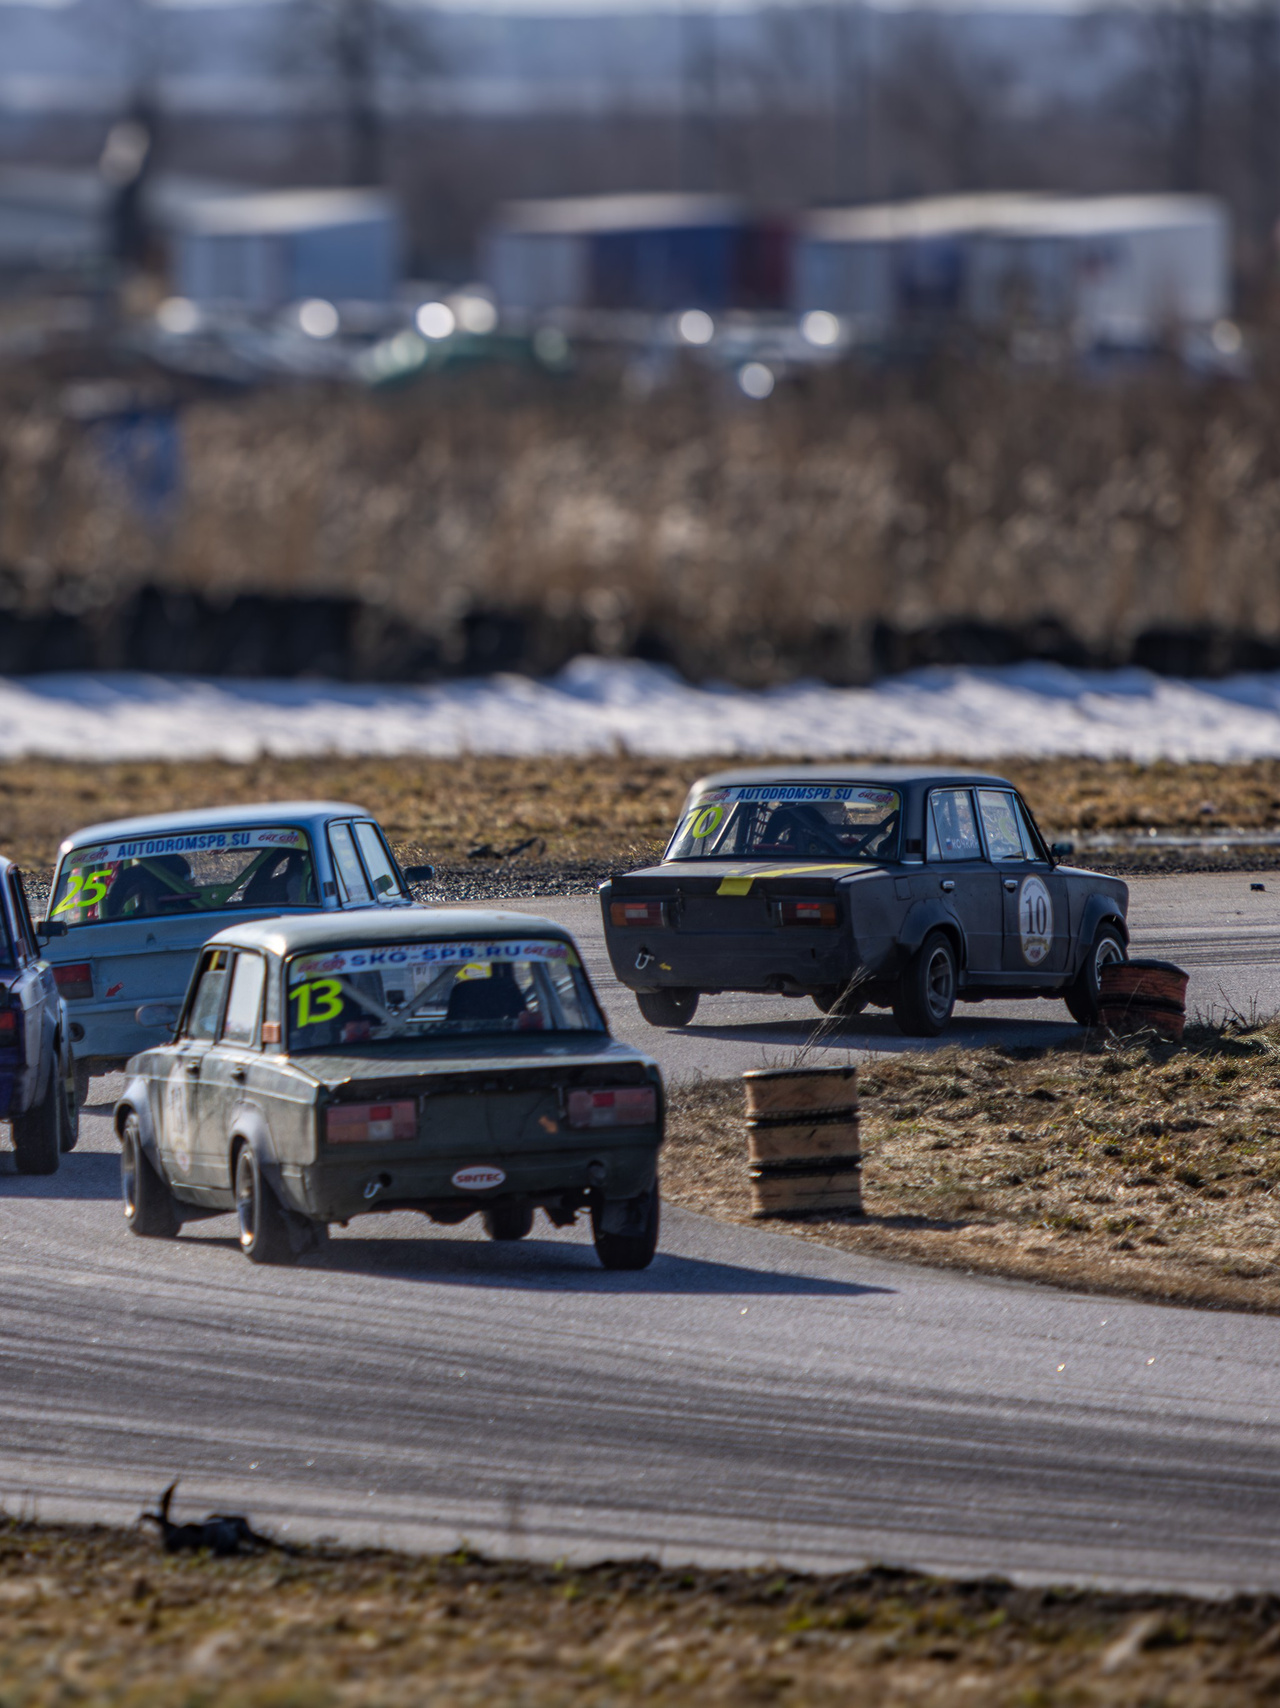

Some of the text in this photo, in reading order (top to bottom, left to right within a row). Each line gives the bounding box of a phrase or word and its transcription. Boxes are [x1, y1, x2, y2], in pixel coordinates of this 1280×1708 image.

[736, 788, 853, 801] AUTODROMSPB.SU
[677, 806, 723, 842] 10
[117, 833, 251, 859] AUTODROMSPB.SU
[50, 869, 112, 917] 25
[1025, 895, 1048, 936] 10
[350, 945, 521, 968] SKG-SPB.RU
[289, 978, 345, 1028] 13
[456, 1173, 502, 1184] SINTEC
